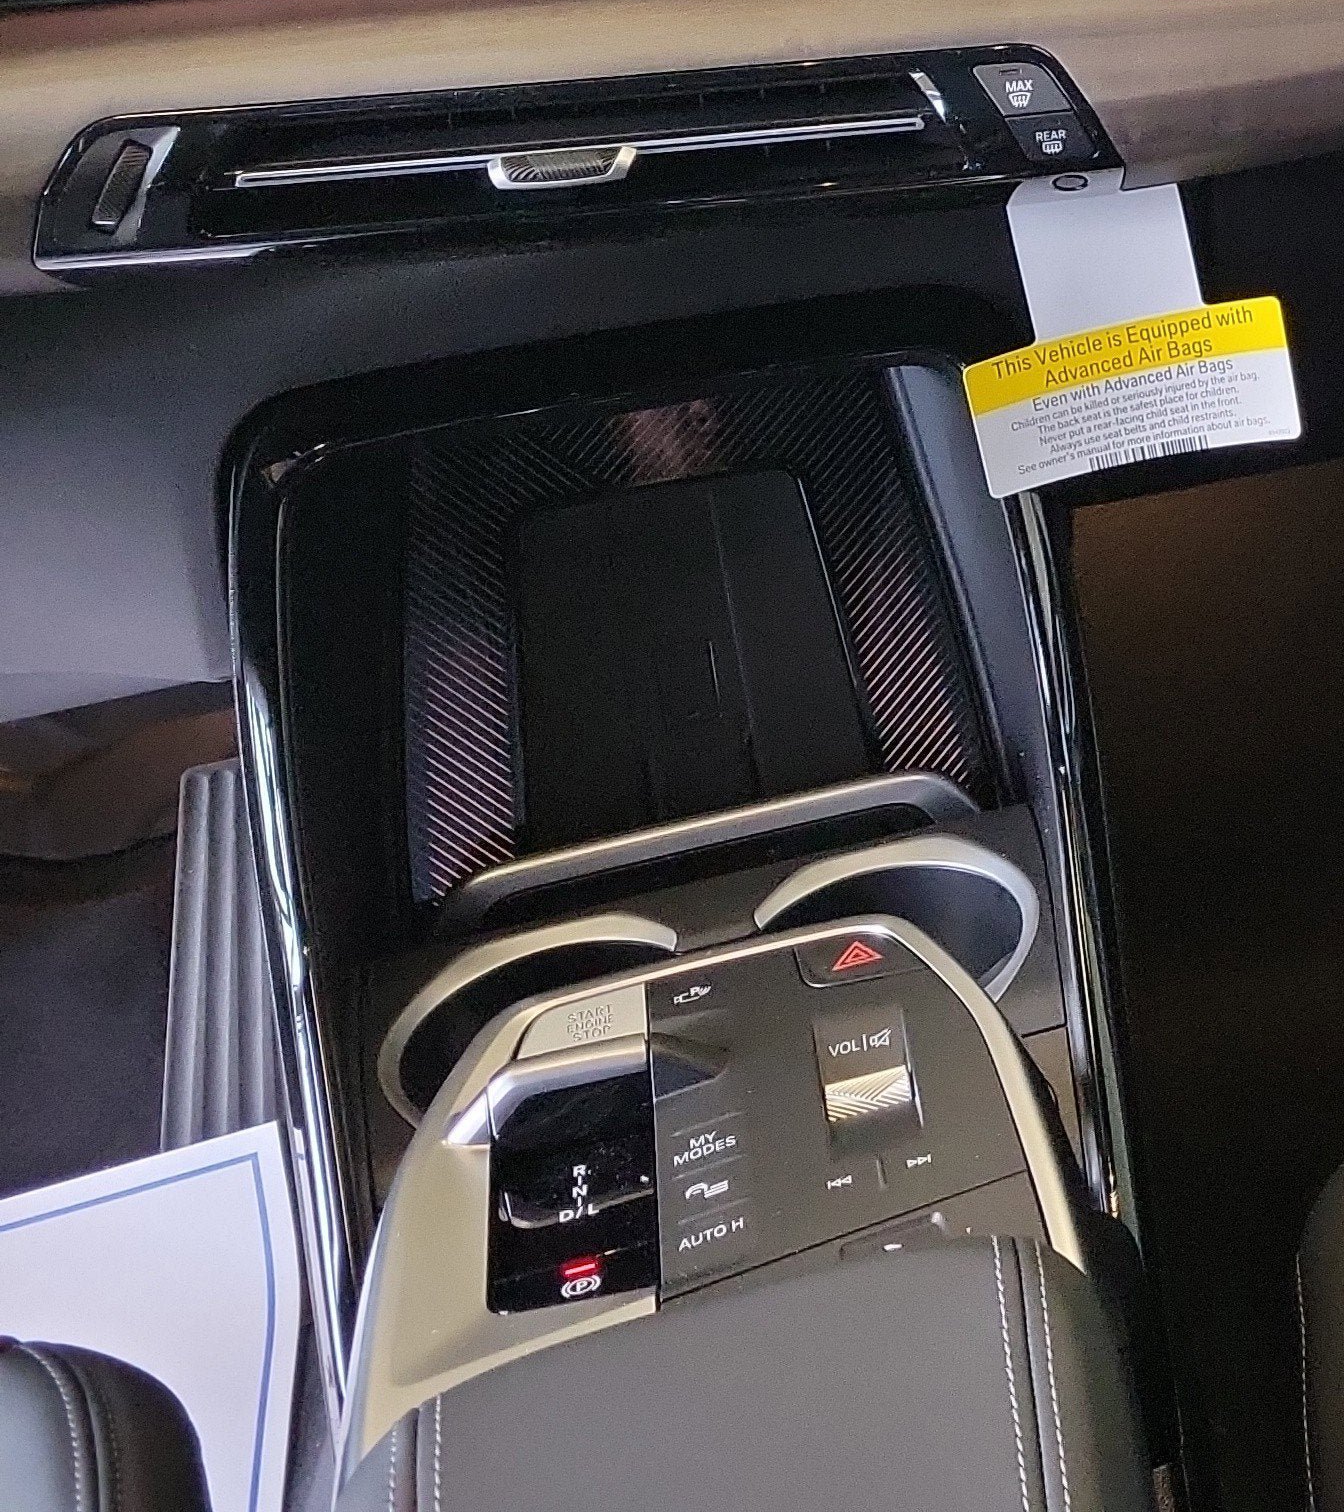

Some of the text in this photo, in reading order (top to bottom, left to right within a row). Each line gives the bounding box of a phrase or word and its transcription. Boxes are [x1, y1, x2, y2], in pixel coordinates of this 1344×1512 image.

[1005, 79, 1033, 93] MAX
[1036, 129, 1066, 142] REAR
[991, 305, 1254, 379] This Vehicle is Equipped with
[1045, 338, 1213, 388] Advanced Air Bags
[1011, 371, 1260, 432] Children can be killed or seriously injured by the air bag.
[1032, 358, 1234, 412] Even with Advanced Air Bags
[1038, 424, 1056, 435] The
[1057, 416, 1080, 429] back
[1081, 411, 1101, 424] seat
[1112, 405, 1129, 416] the
[1129, 399, 1159, 413] safest
[1159, 394, 1185, 408] place
[1185, 392, 1199, 402] for
[1199, 385, 1241, 399] children.
[1038, 433, 1068, 447] Never
[1068, 427, 1087, 440] put
[1093, 414, 1145, 432] rear-facing
[1145, 408, 1169, 420] child
[1170, 404, 1190, 416] seat
[1200, 399, 1217, 409] the
[1217, 395, 1243, 407] front.
[1017, 414, 1272, 476] See owner's manual for more information about air bags.
[1049, 407, 1238, 454] Always use seat belts and child restraints.
[566, 1013, 615, 1034] ENGINE
[567, 1003, 613, 1024] START
[573, 1025, 612, 1042] STOP
[828, 1039, 861, 1057] VOL
[673, 1135, 737, 1167] MODES
[690, 1131, 717, 1149] MY
[678, 1217, 744, 1251] AUTO H
